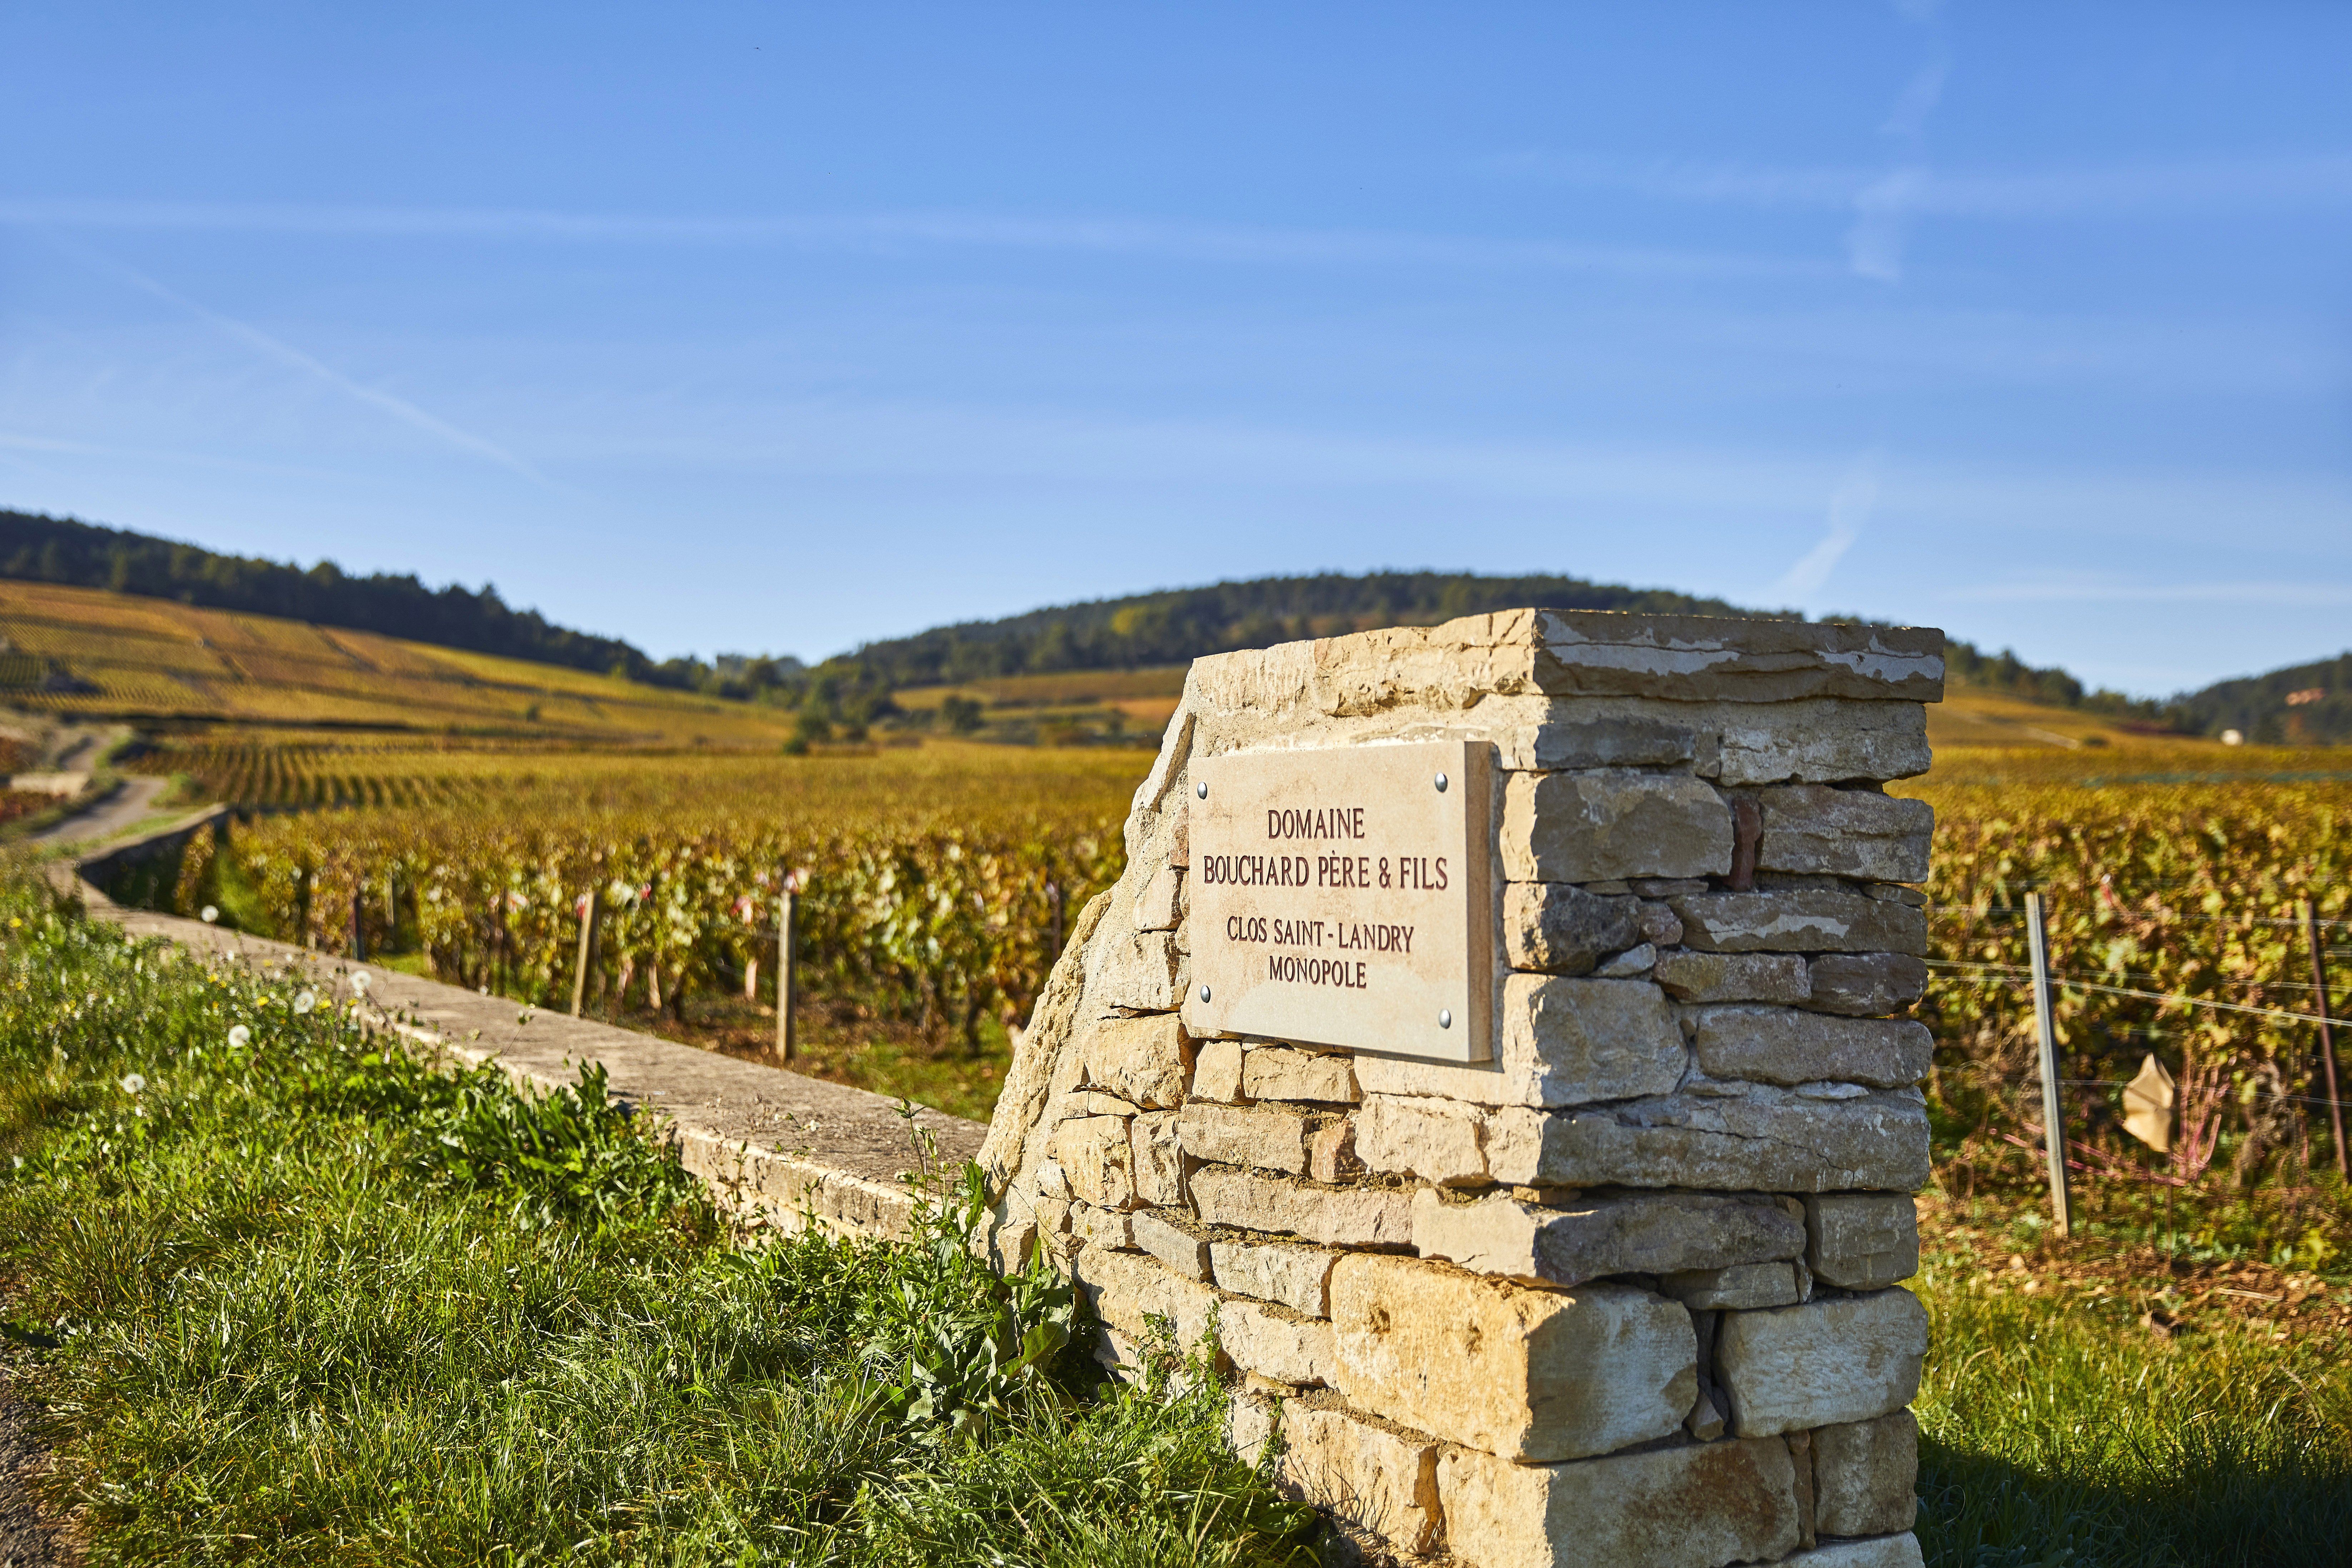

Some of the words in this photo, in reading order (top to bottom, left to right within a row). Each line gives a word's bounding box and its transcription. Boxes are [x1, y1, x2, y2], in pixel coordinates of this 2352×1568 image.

[1268, 808, 1365, 839] DOMAINE
[1204, 855, 1309, 887] BOUCHARD
[1318, 850, 1370, 888] PÈRE
[1379, 857, 1391, 889] &
[1400, 857, 1448, 890] FILS
[1227, 916, 1267, 943] CLOS
[1269, 956, 1367, 989] MONOPOLE
